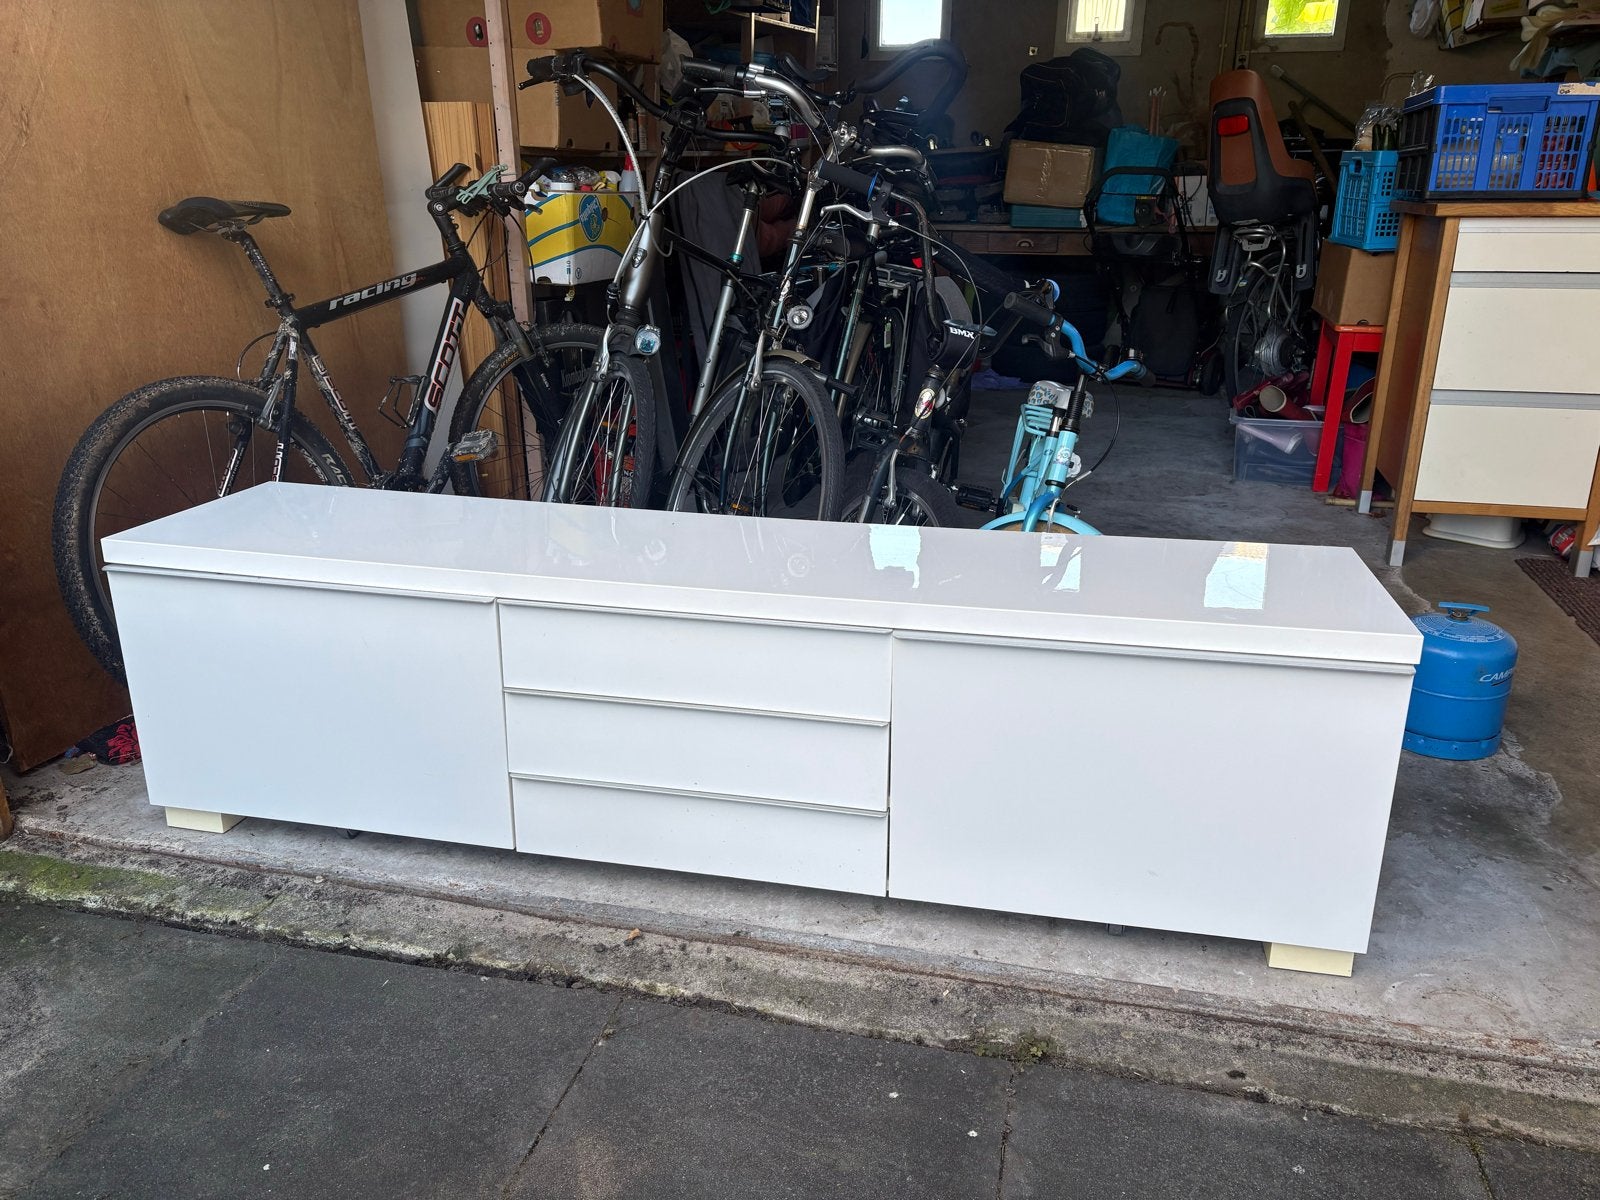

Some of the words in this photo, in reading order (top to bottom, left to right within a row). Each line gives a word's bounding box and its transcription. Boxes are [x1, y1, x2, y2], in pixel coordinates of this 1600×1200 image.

[329, 272, 418, 311] racing
[949, 326, 975, 340] BMX
[426, 299, 465, 413] SCOTT
[321, 453, 351, 487] RAC
